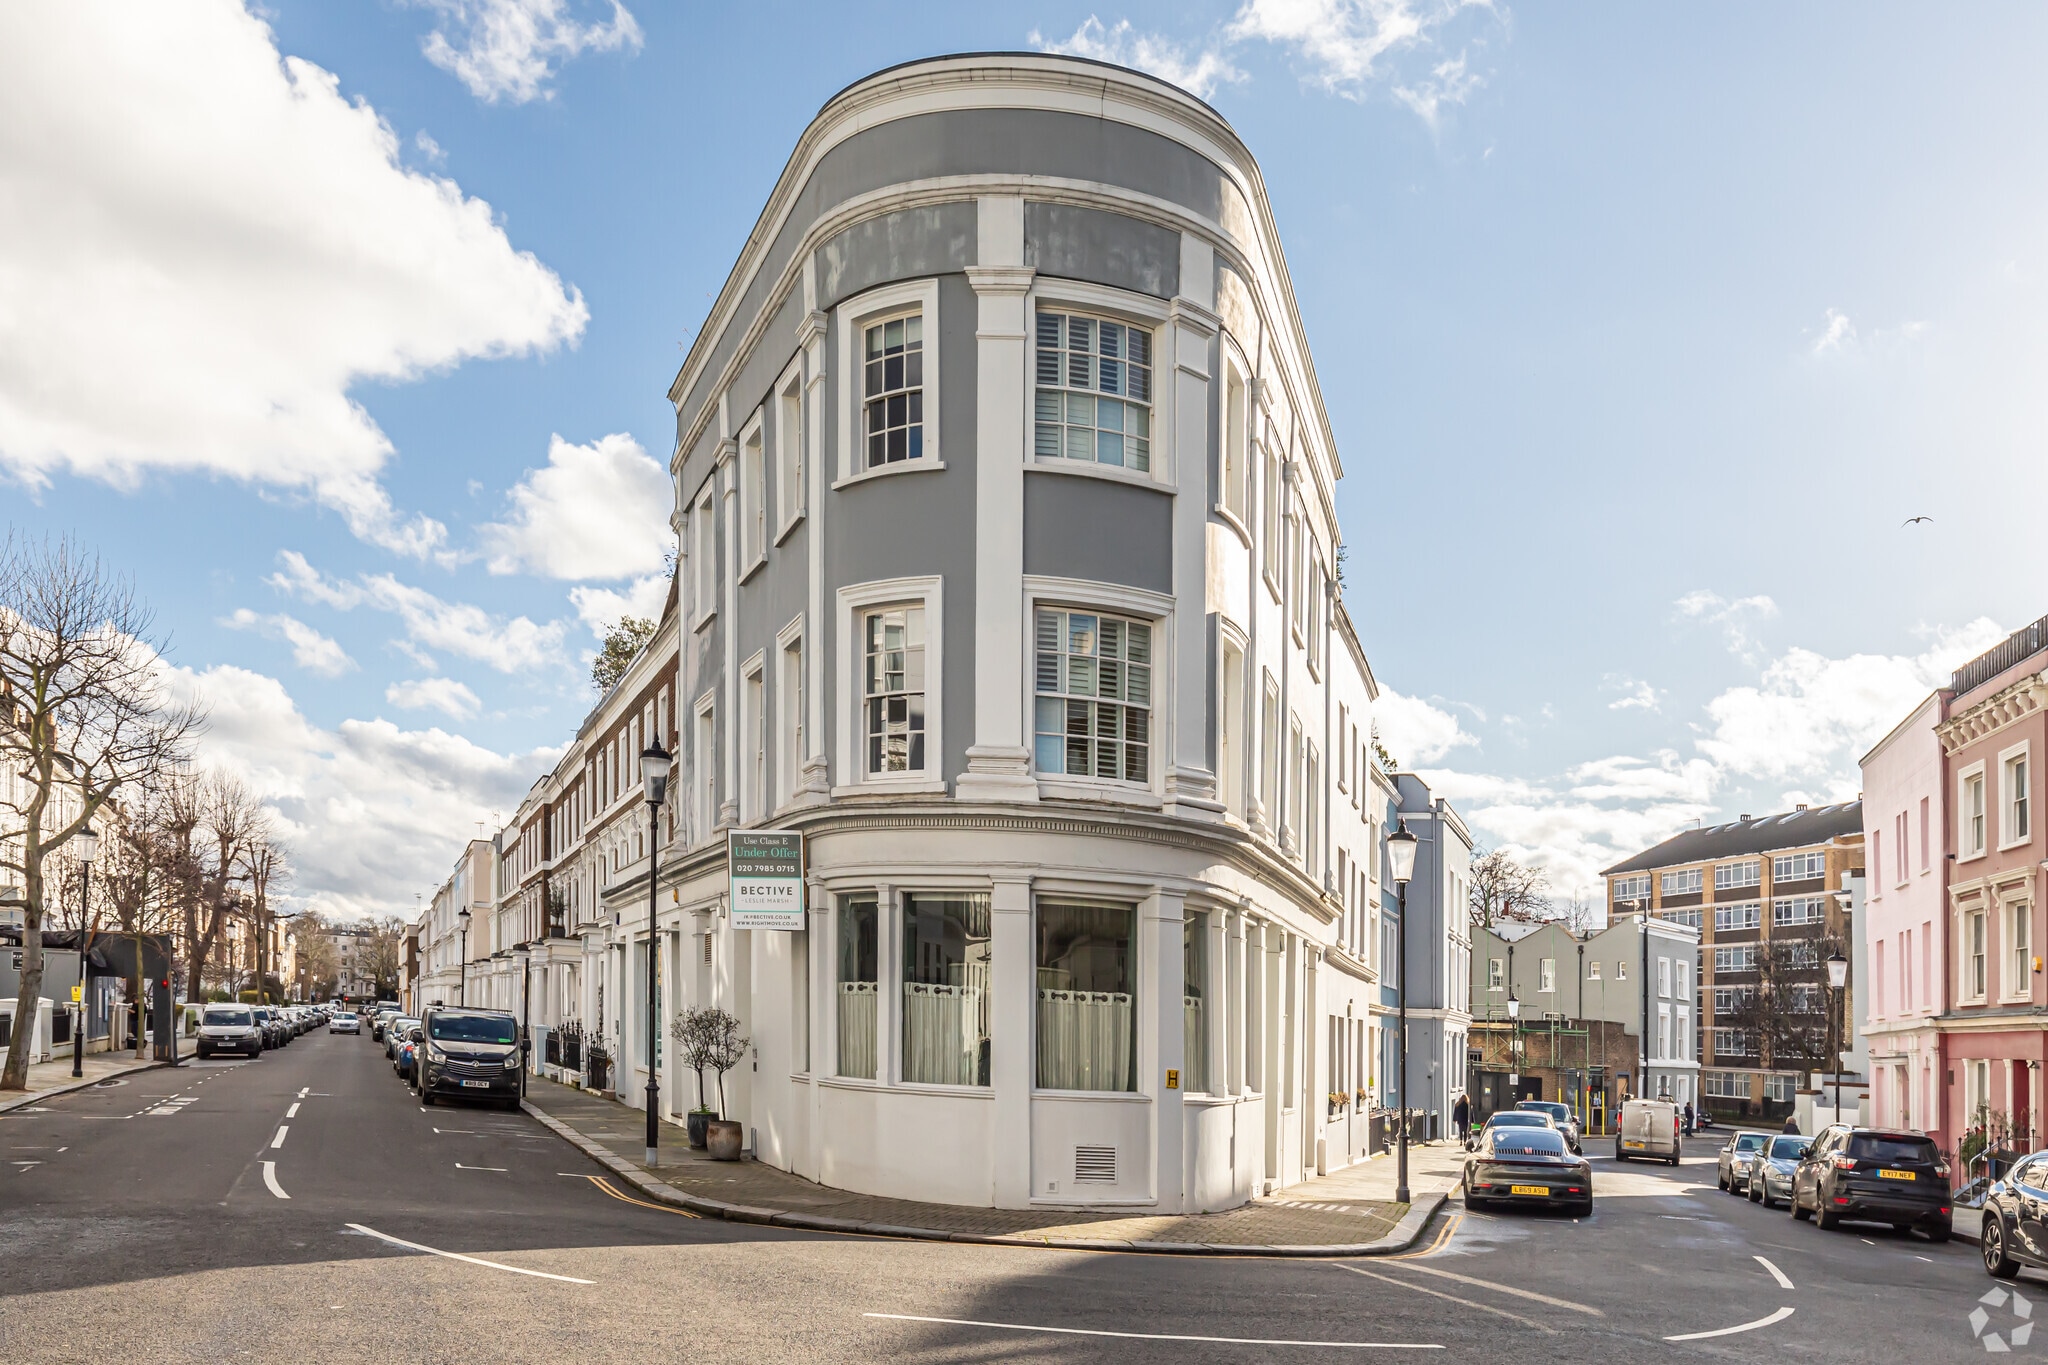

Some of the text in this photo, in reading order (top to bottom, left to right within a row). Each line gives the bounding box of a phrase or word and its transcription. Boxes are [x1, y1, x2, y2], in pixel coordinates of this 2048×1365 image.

[743, 836, 788, 845] Use Class E
[735, 846, 798, 858] Under Offer
[737, 864, 795, 873] 020 7985 0715
[740, 885, 793, 896] BECTIVE
[1168, 1071, 1178, 1087] H
